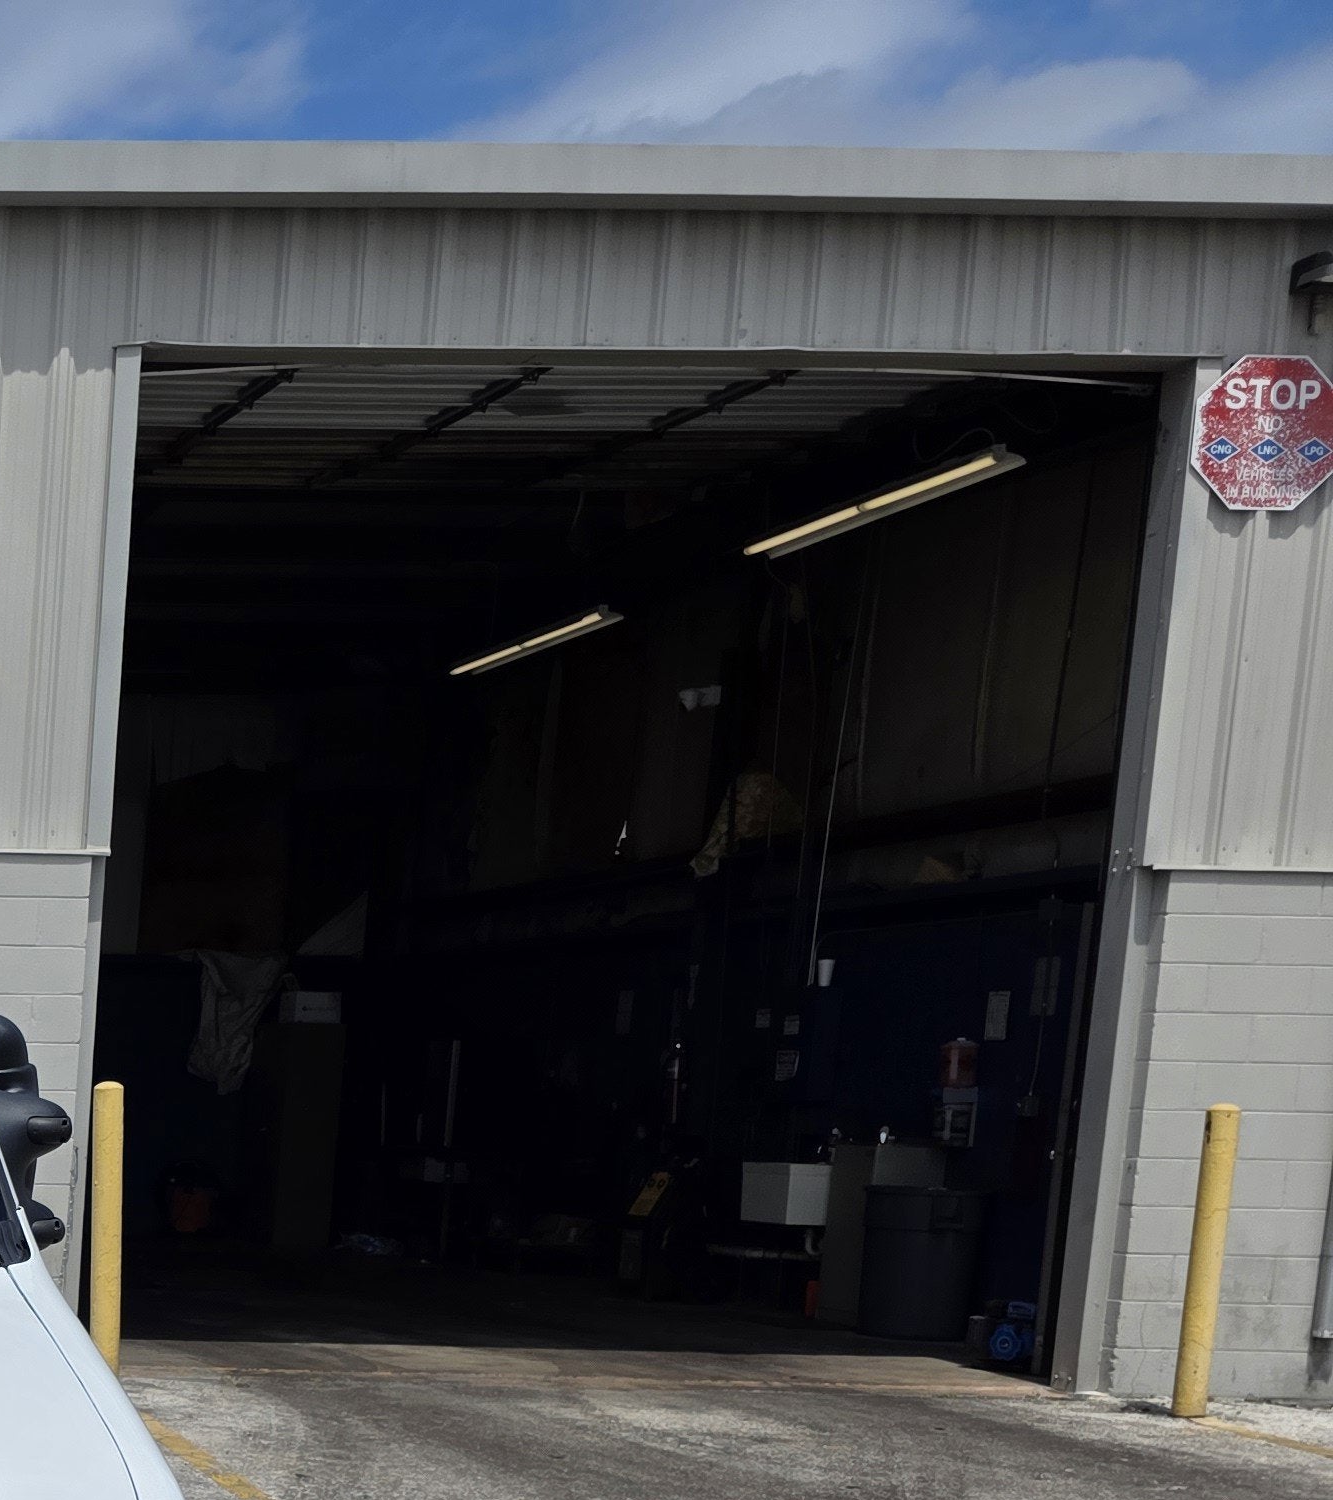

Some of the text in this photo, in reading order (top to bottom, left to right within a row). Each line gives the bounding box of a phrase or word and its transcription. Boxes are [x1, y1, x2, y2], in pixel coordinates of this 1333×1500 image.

[1224, 378, 1321, 410] STOP
[1257, 415, 1284, 433] NO
[1210, 444, 1325, 456] CNG LNG LPG
[1235, 467, 1295, 481] VEHICLES
